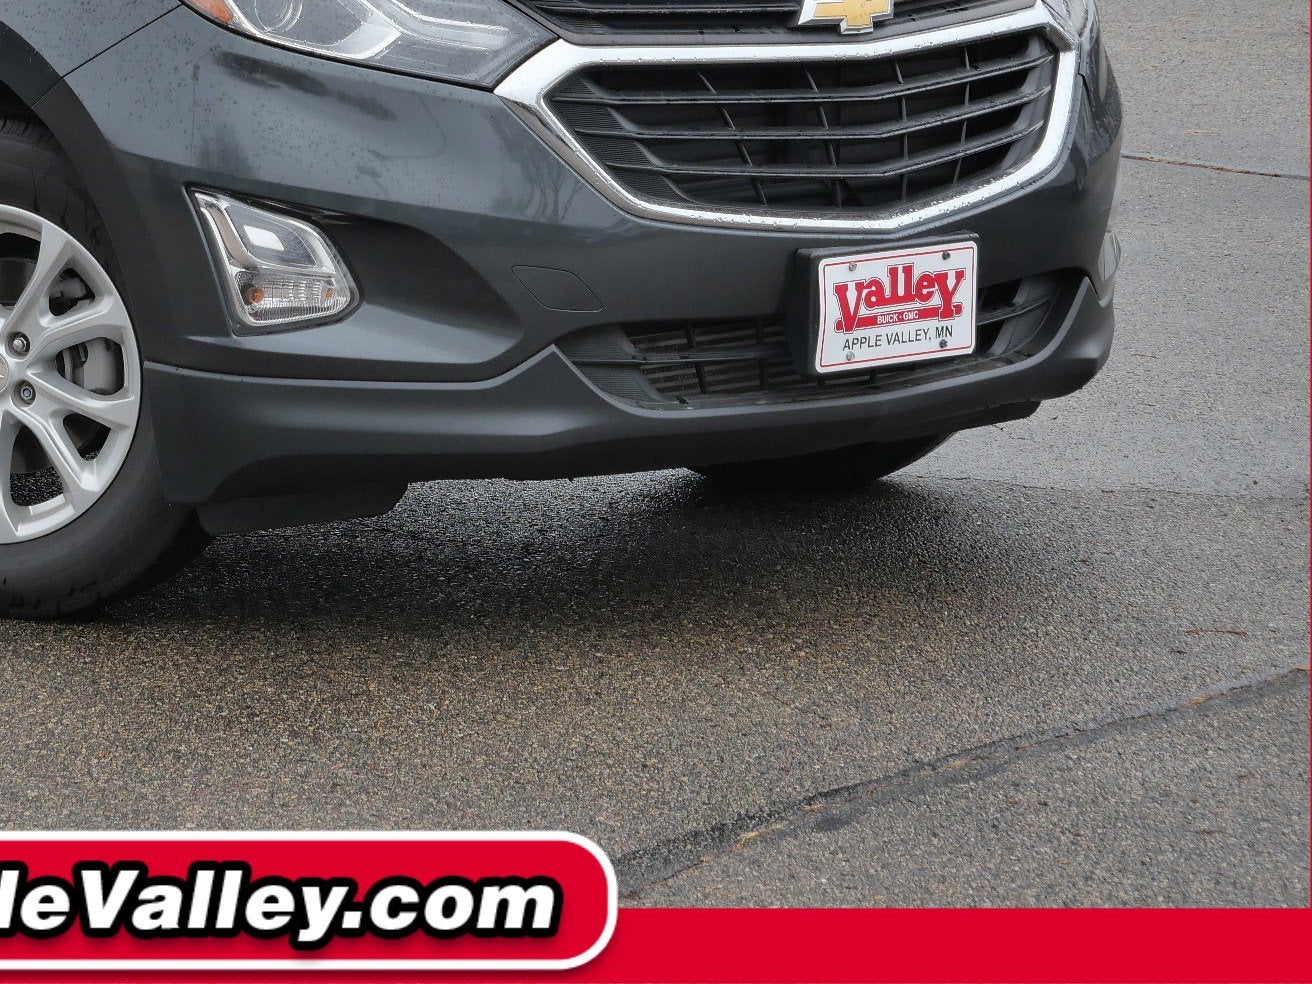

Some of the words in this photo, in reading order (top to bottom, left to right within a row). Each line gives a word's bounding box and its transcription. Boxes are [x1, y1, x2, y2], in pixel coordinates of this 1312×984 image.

[877, 313, 899, 325] BUICK
[902, 310, 919, 321] GMC
[842, 334, 882, 352] APPLE
[885, 328, 932, 346] VALLEY,
[935, 324, 954, 339] MN
